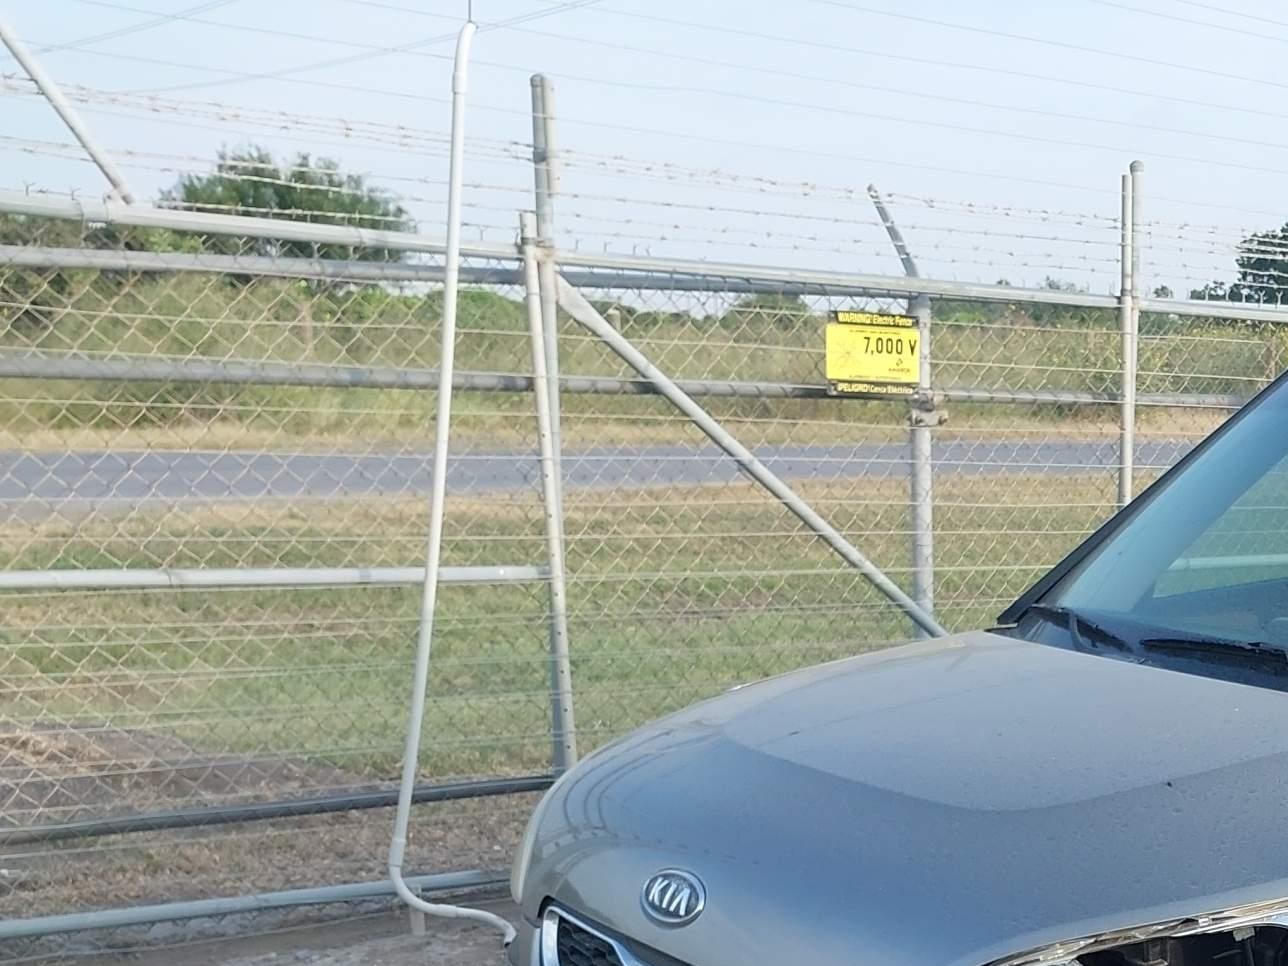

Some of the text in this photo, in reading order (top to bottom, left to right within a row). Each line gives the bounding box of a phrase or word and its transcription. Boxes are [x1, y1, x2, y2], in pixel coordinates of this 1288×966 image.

[863, 336, 917, 356] 7,000 V
[648, 876, 691, 916] KIA
